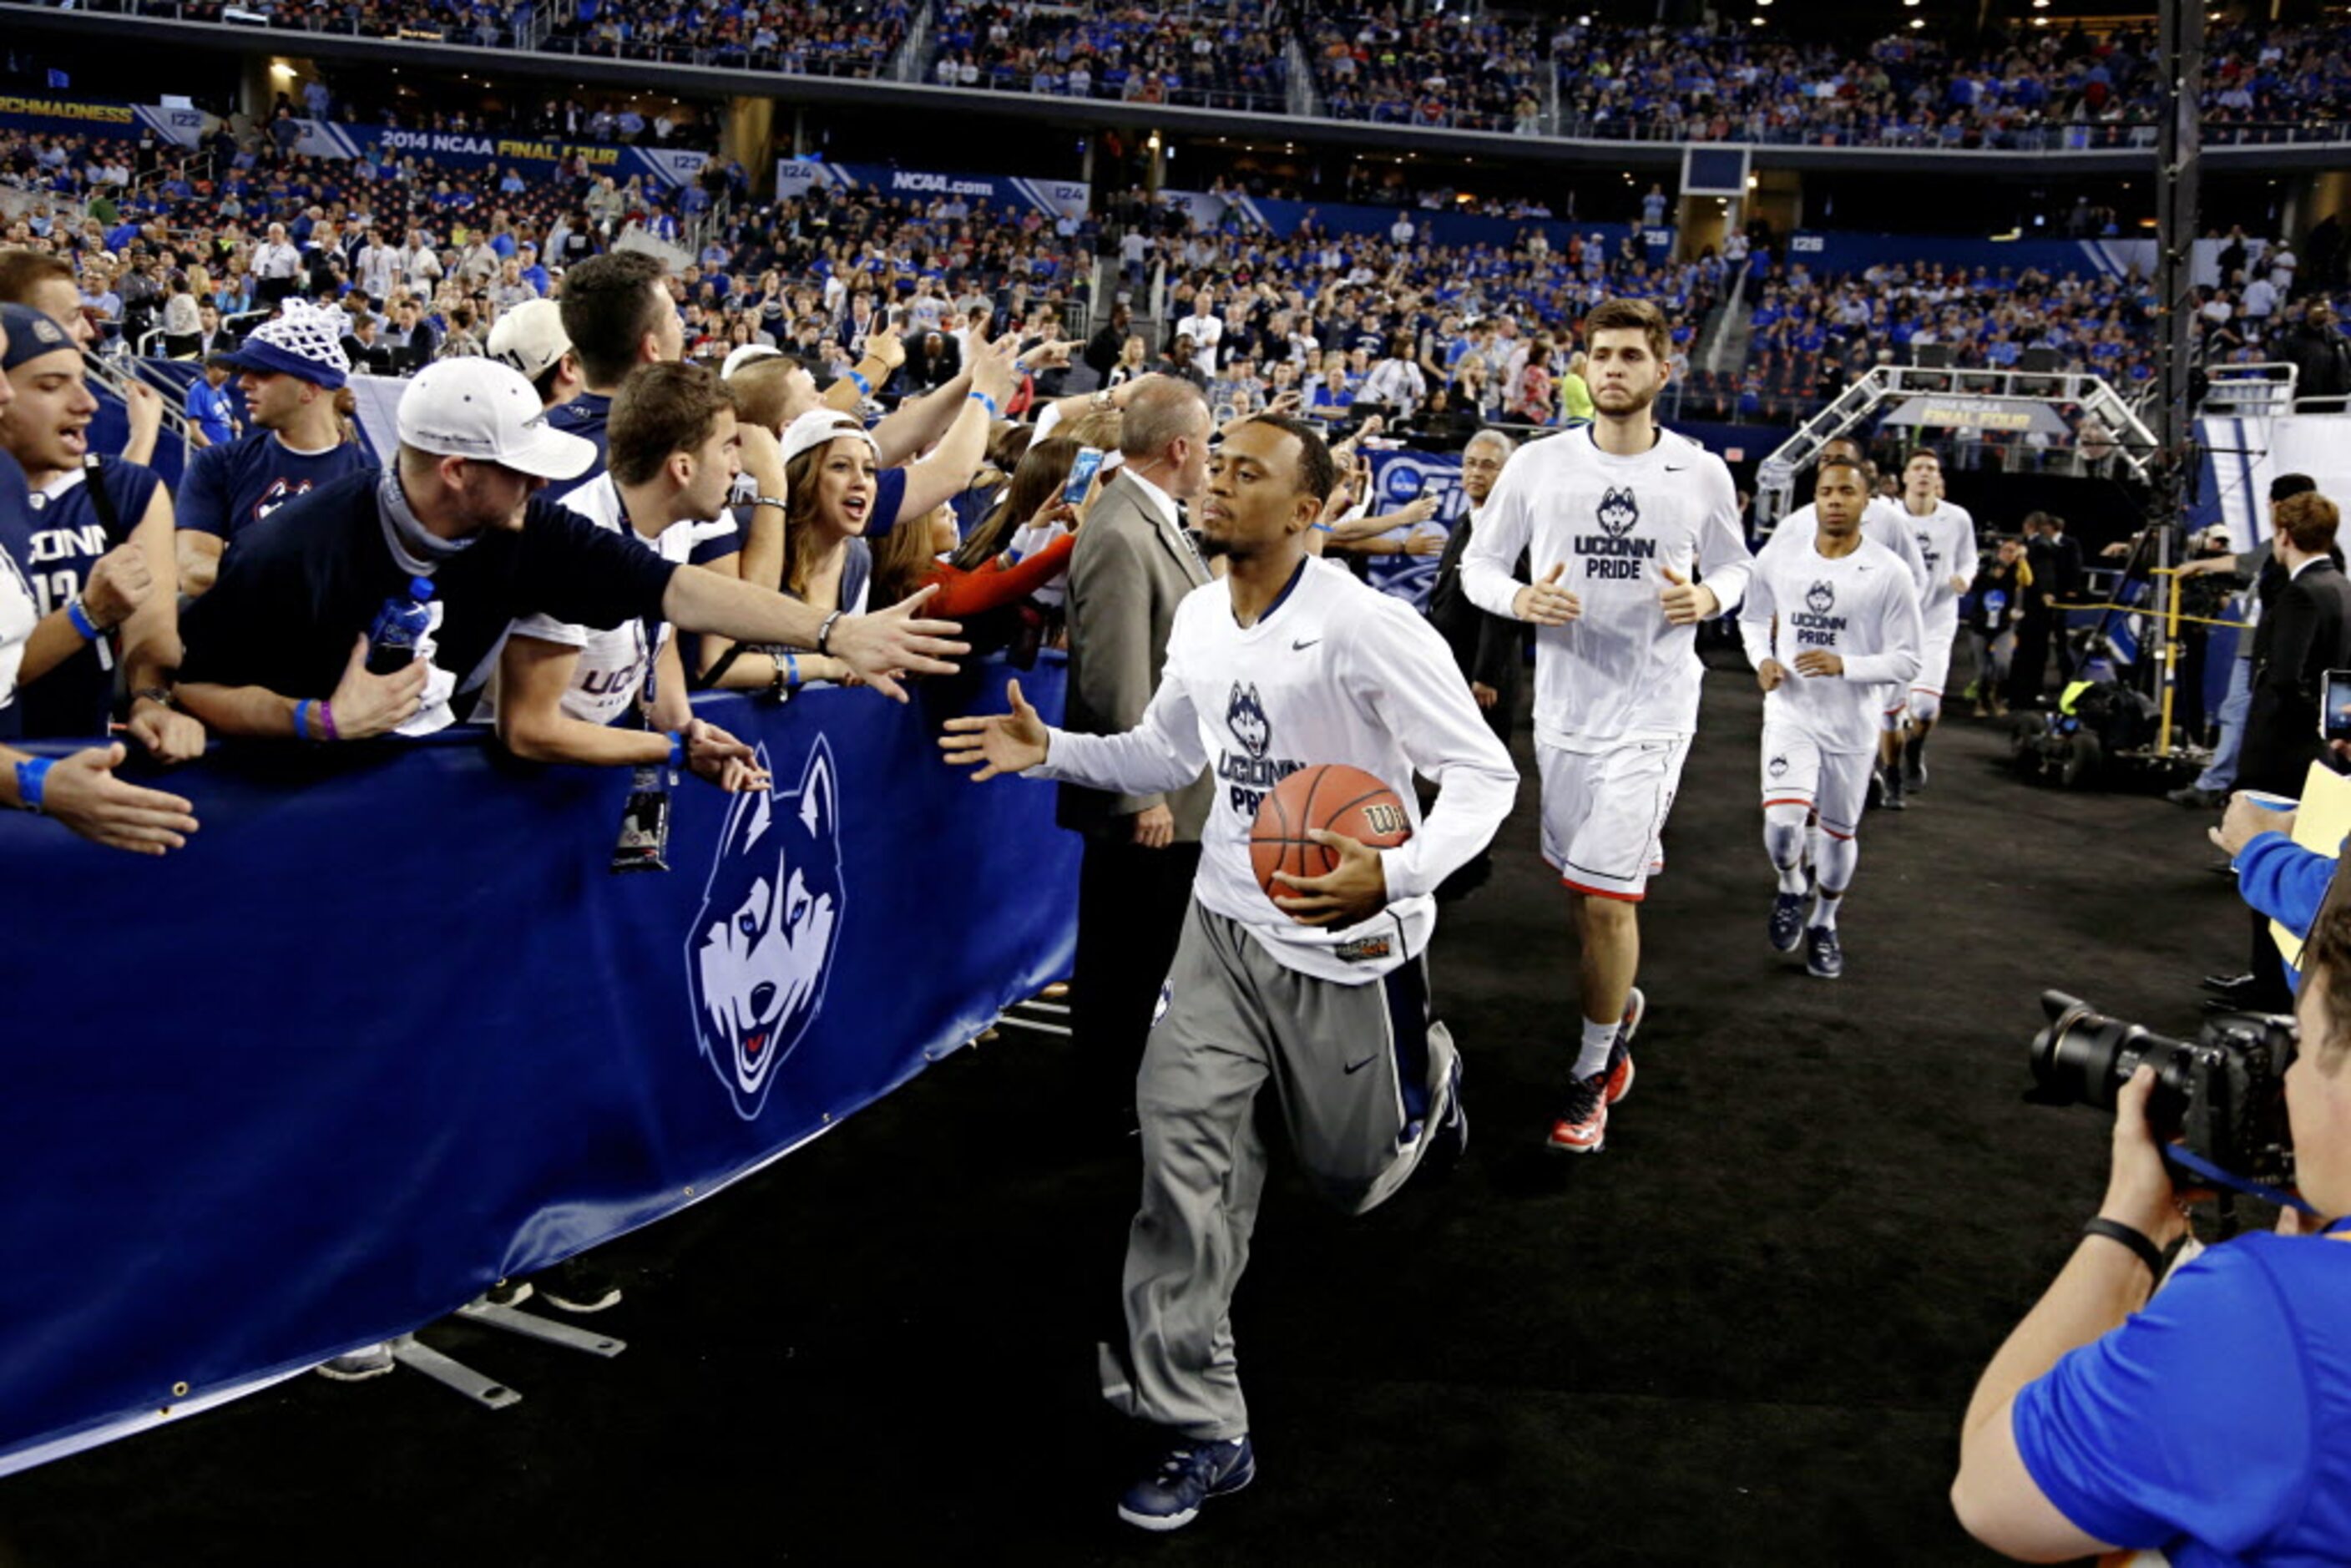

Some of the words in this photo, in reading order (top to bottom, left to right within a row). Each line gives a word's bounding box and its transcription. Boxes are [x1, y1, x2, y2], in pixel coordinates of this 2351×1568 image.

[171, 113, 201, 126] 122
[381, 130, 428, 149] 2014
[432, 134, 494, 156] NCAA
[497, 139, 559, 160] FINAL
[782, 164, 811, 179] 124
[892, 171, 993, 196] NCAA.com
[1054, 186, 1084, 201] 124
[1574, 535, 1656, 558] UCONN
[1585, 558, 1641, 579] PRIDE
[1791, 612, 1847, 630] UCONN
[1797, 629, 1836, 645] PRIDE
